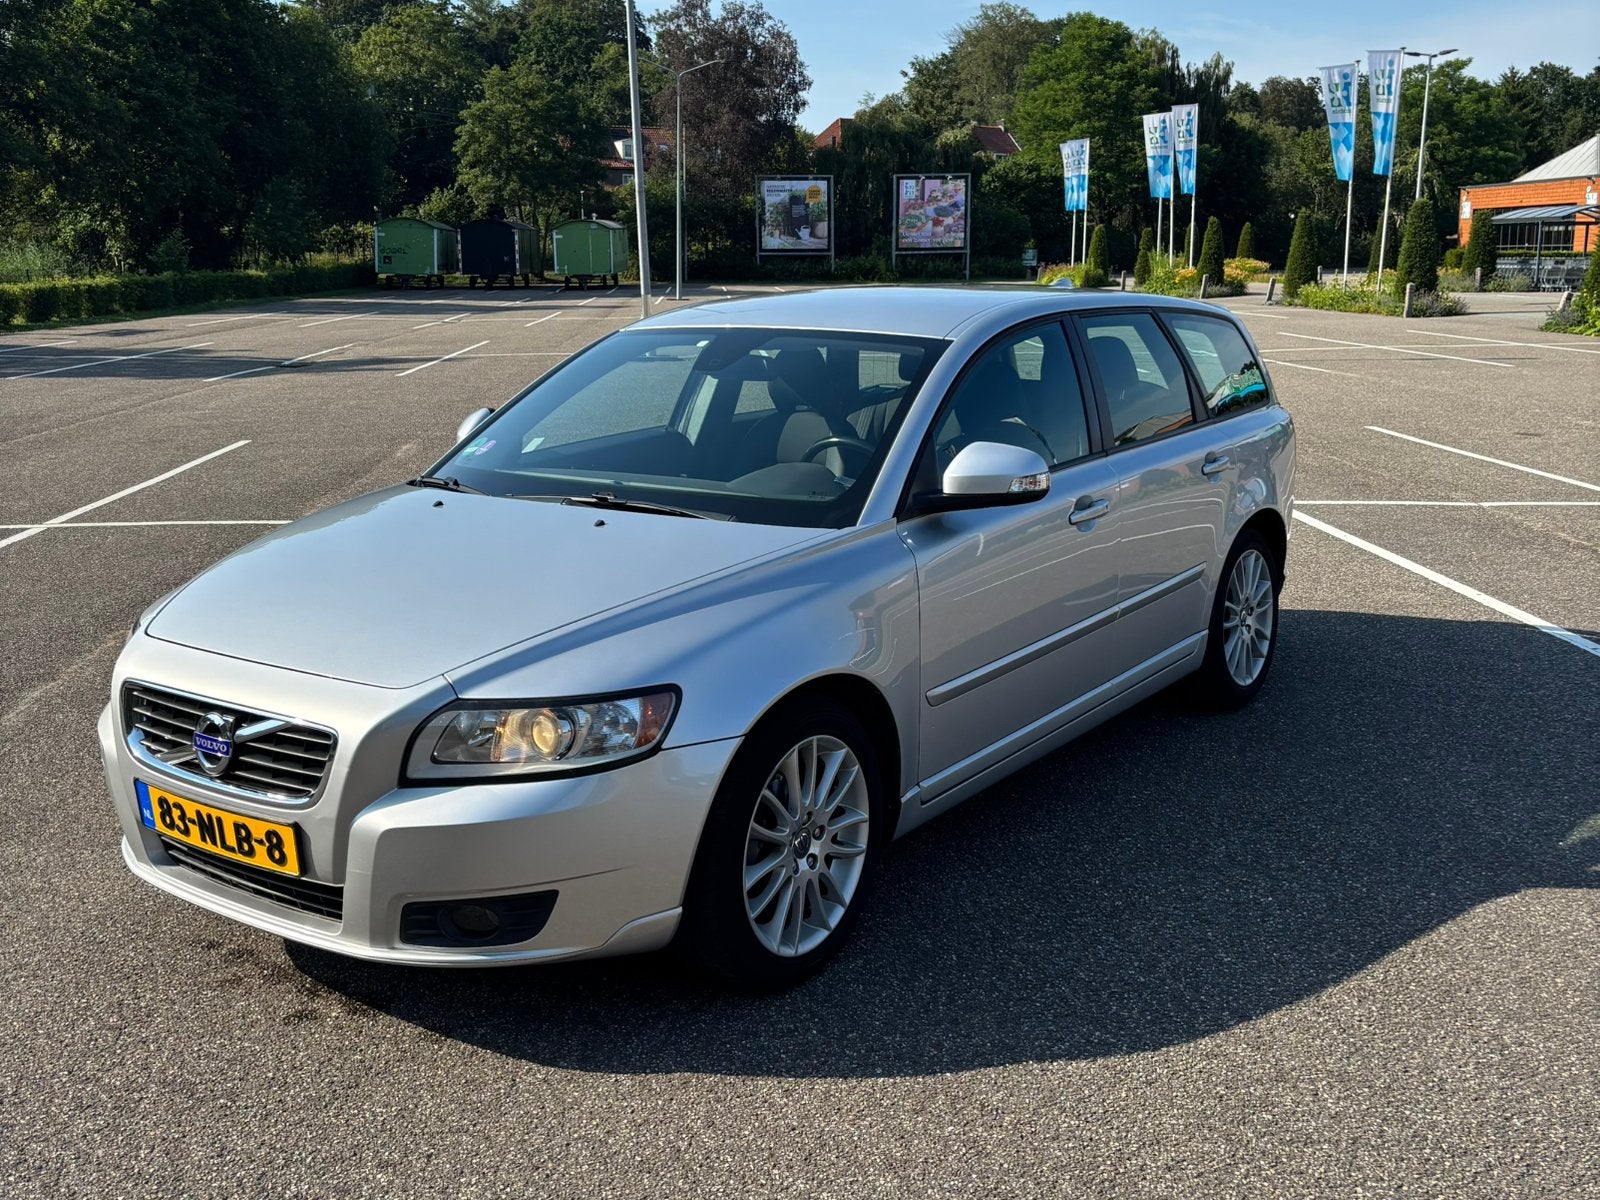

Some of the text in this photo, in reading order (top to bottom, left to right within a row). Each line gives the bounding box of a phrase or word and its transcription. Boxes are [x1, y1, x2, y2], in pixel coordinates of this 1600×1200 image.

[195, 736, 227, 752] VOLVO
[143, 808, 154, 820] NL
[157, 795, 287, 867] 83-NLB-8
